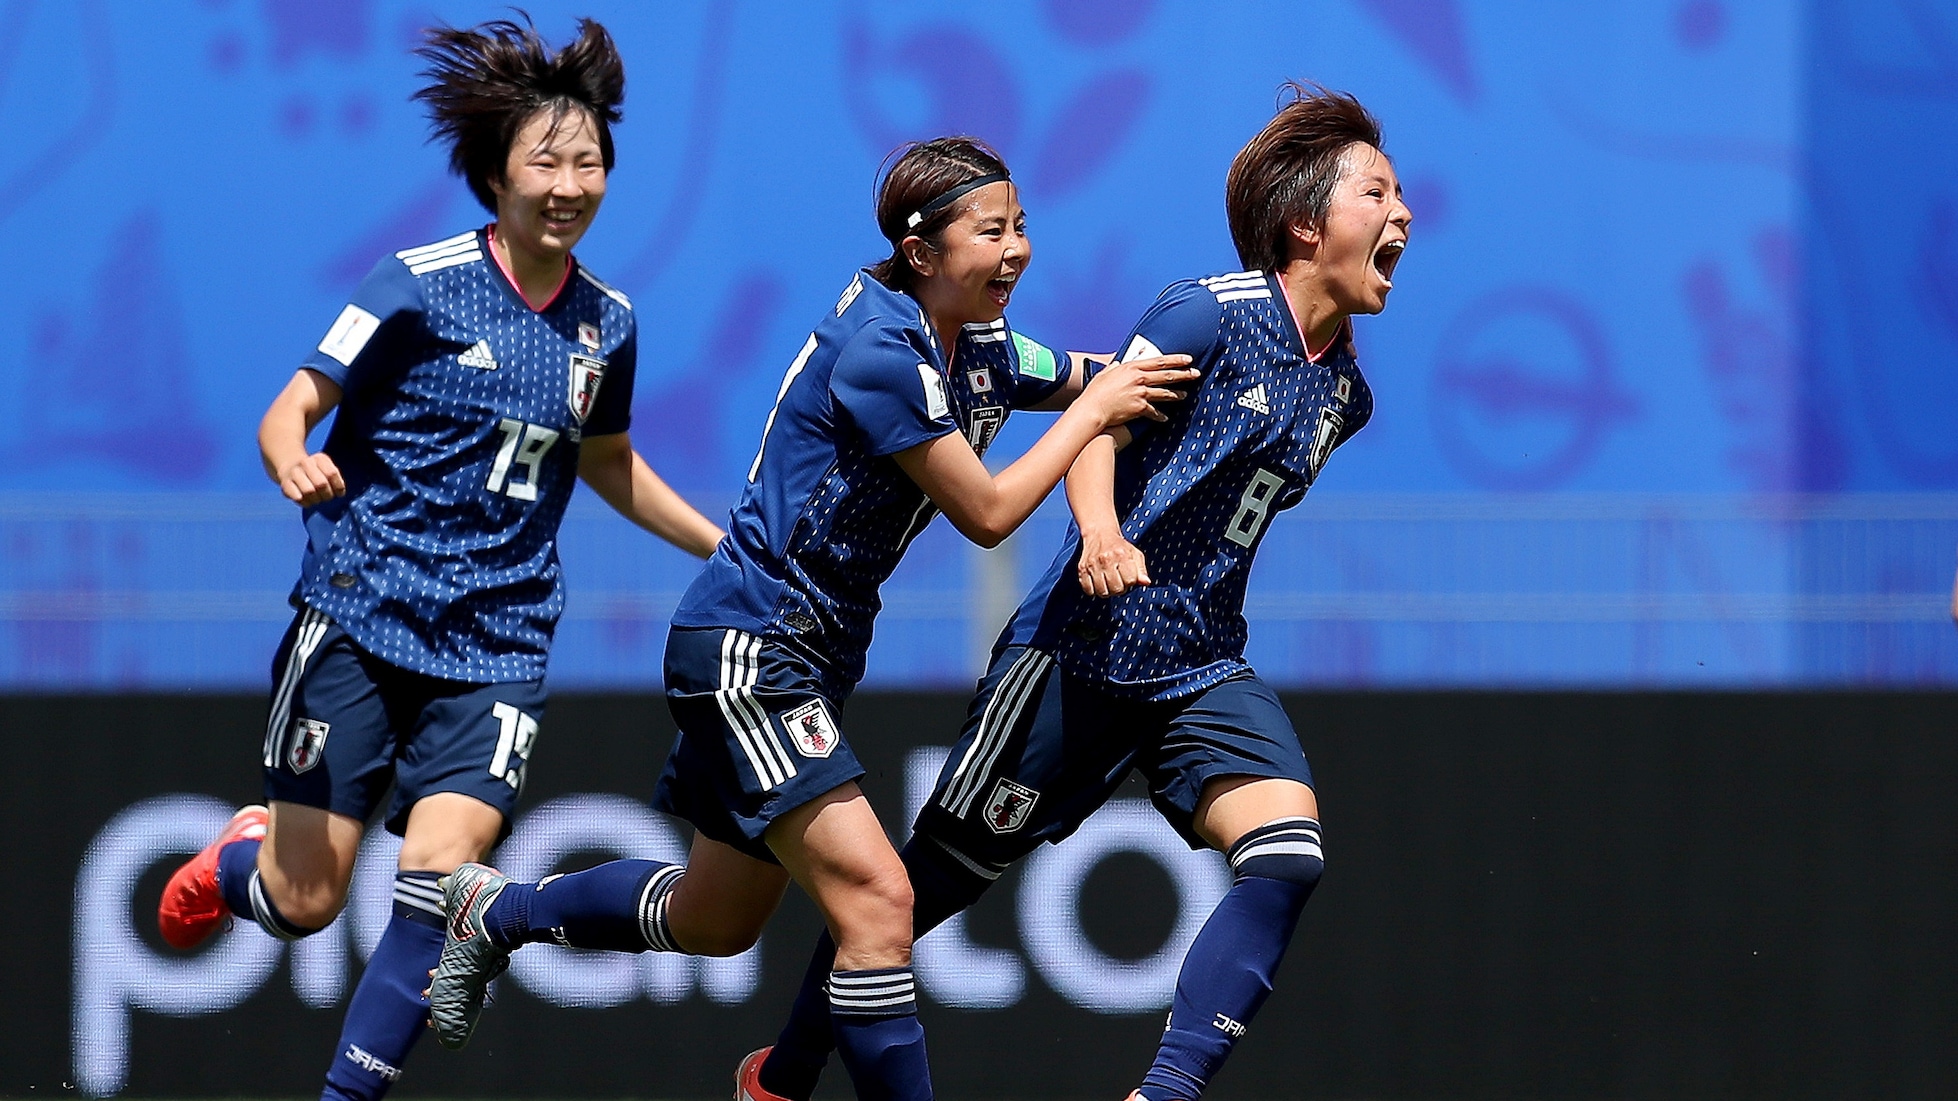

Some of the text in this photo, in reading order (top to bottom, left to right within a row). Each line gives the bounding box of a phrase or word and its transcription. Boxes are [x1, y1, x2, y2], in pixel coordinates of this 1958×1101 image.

[457, 354, 498, 371] adidas
[1237, 395, 1270, 416] adidas
[486, 417, 561, 502] 19
[1224, 467, 1286, 549] 8
